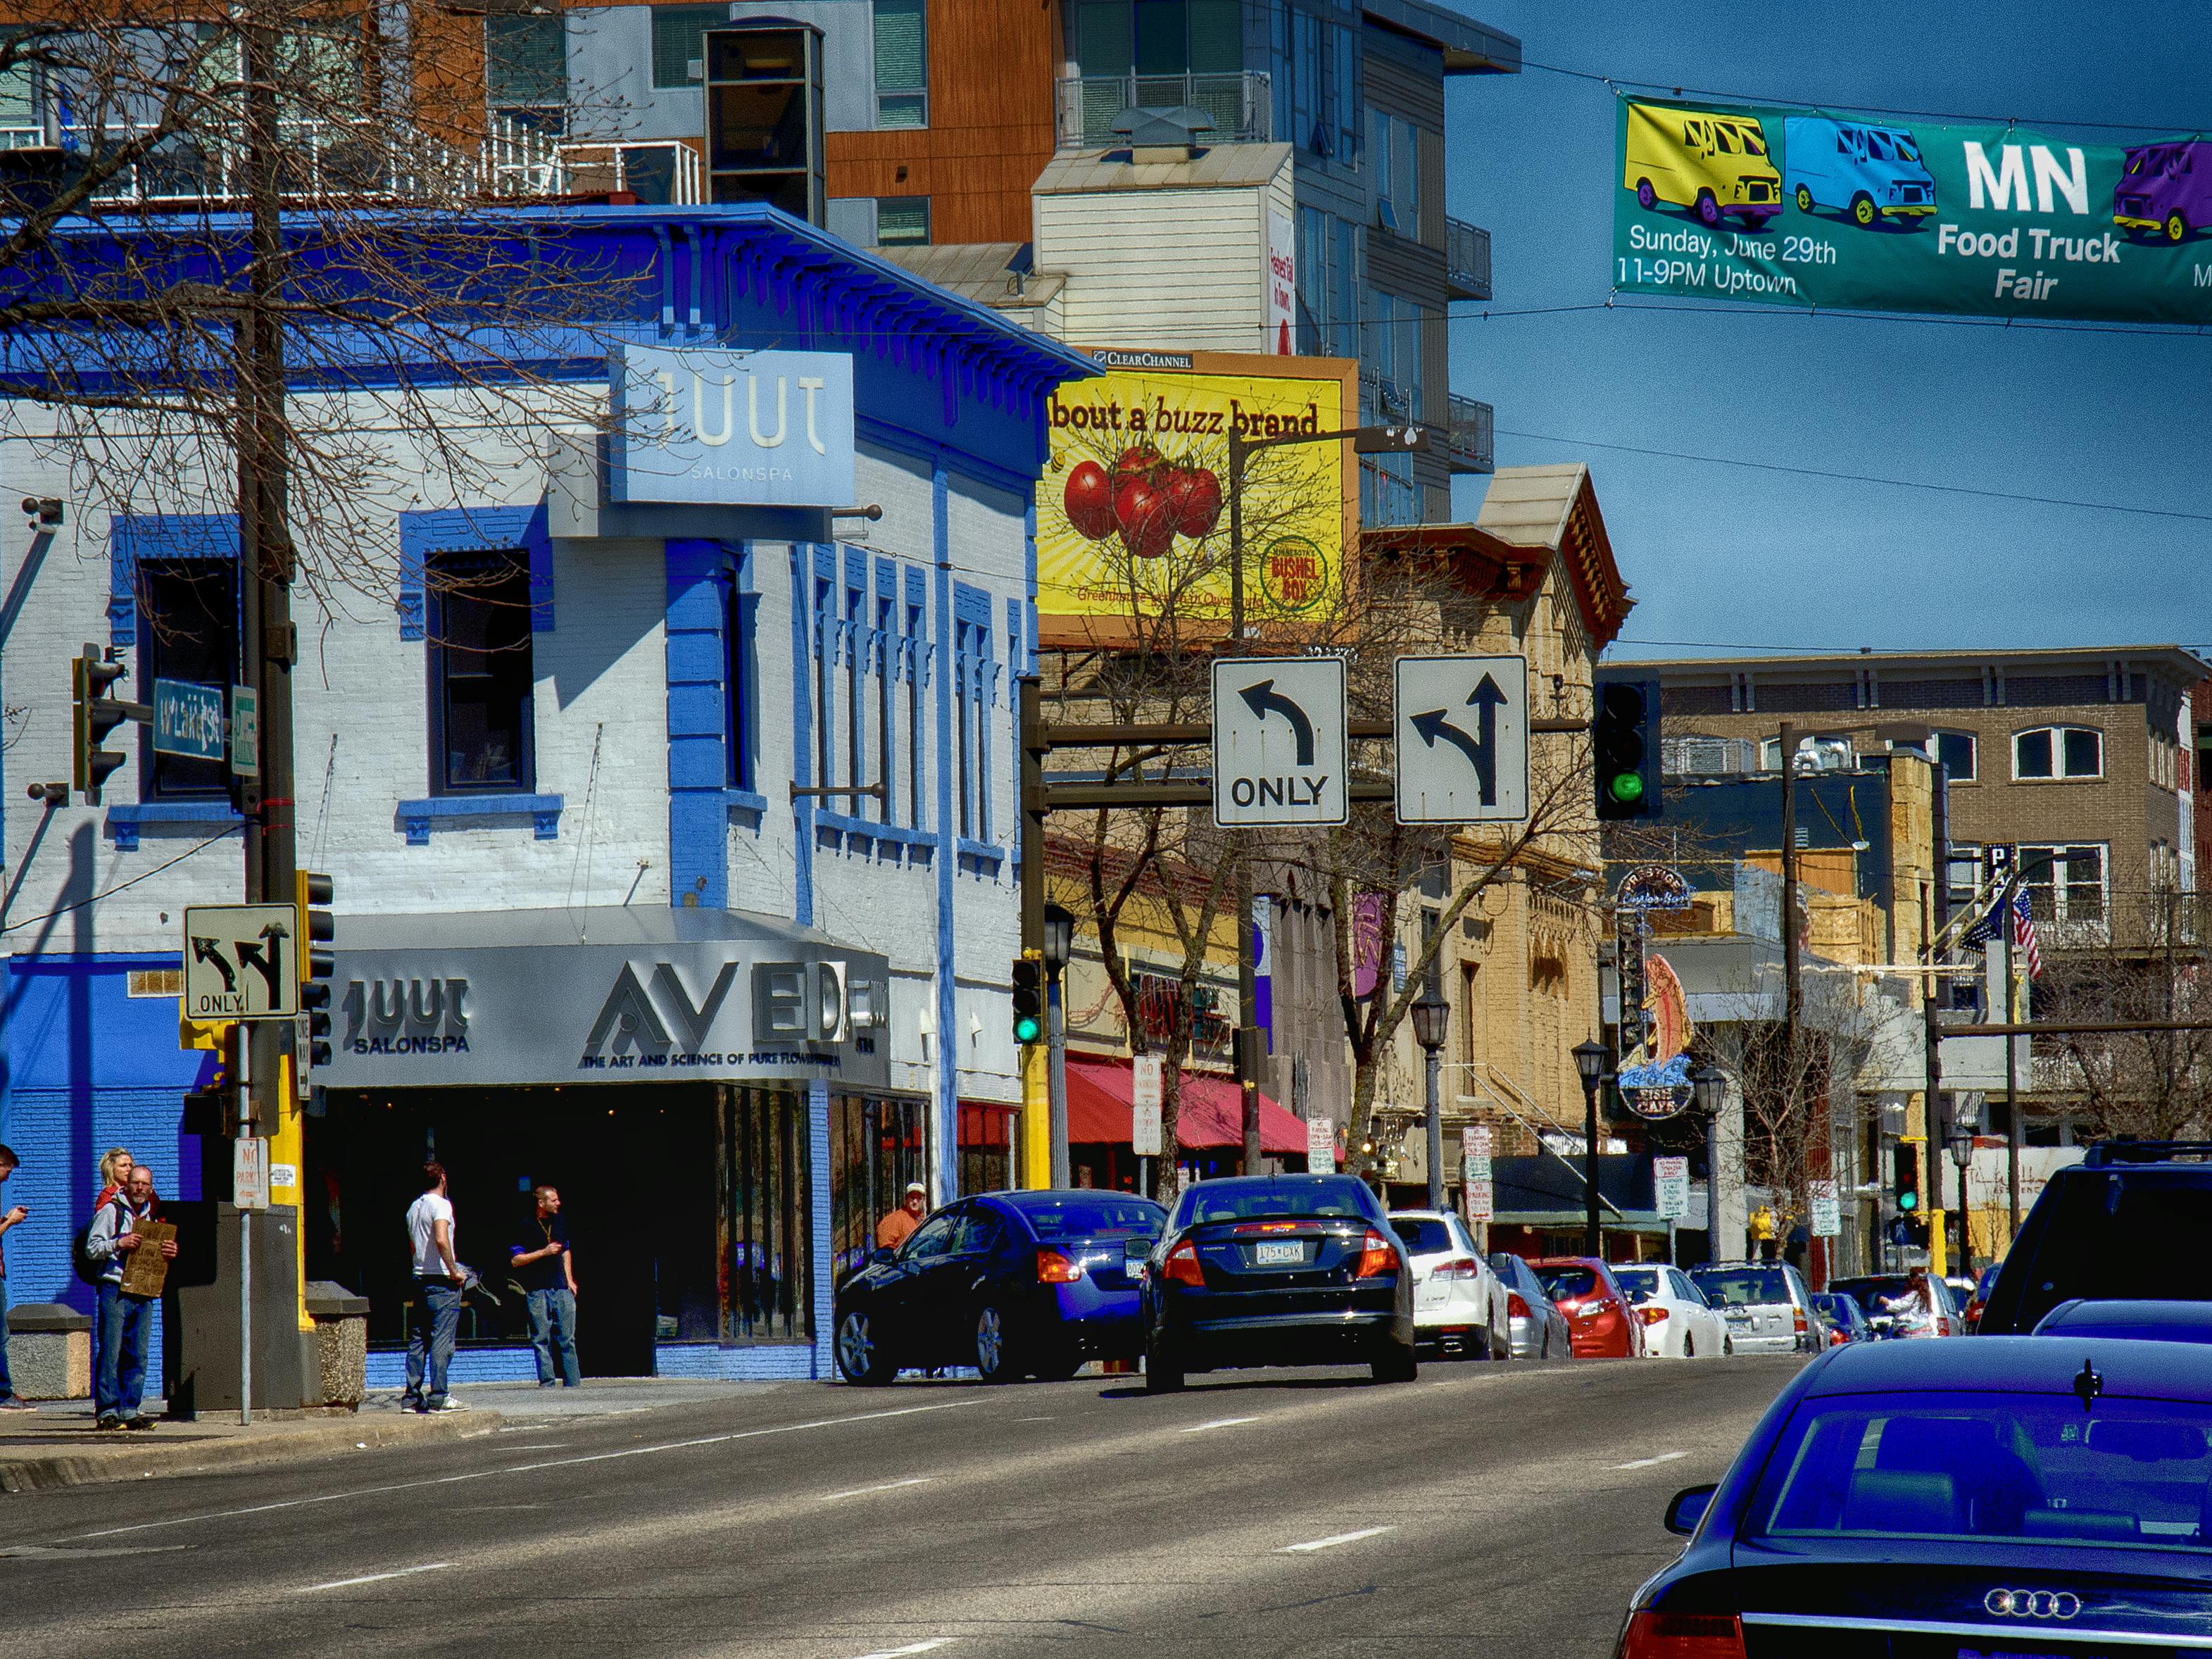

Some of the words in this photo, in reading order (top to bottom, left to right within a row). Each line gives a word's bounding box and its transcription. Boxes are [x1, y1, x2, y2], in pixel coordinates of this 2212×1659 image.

[1963, 140, 2090, 215] MN
[1629, 224, 1718, 260] Sunday,
[1723, 232, 1777, 261] June
[1781, 235, 1837, 265] 29th
[1937, 223, 2019, 258] Food
[2028, 227, 2121, 264] Truck
[1619, 257, 1707, 287] 11-9PM
[1714, 263, 1797, 295] Uptown
[1994, 268, 2059, 301] Fair
[1048, 390, 1121, 432] bout
[1128, 407, 1149, 433] a
[1157, 394, 1224, 435] buzz
[690, 465, 793, 482] SALONSPA
[1271, 556, 1319, 580] BUSHEL
[1231, 776, 1329, 807] ONLY
[200, 994, 242, 1012] ONLY
[354, 1035, 470, 1055] SALONSPA
[583, 1056, 605, 1068] THE
[608, 1055, 634, 1068] ART
[639, 1056, 668, 1068] AND
[671, 1053, 722, 1067] SCIENCE
[727, 1052, 744, 1065] OF
[748, 1053, 778, 1065] PURE
[1140, 1064, 1154, 1077] NO
[1260, 1246, 1276, 1258] 175
[1283, 1246, 1300, 1257] CXK
